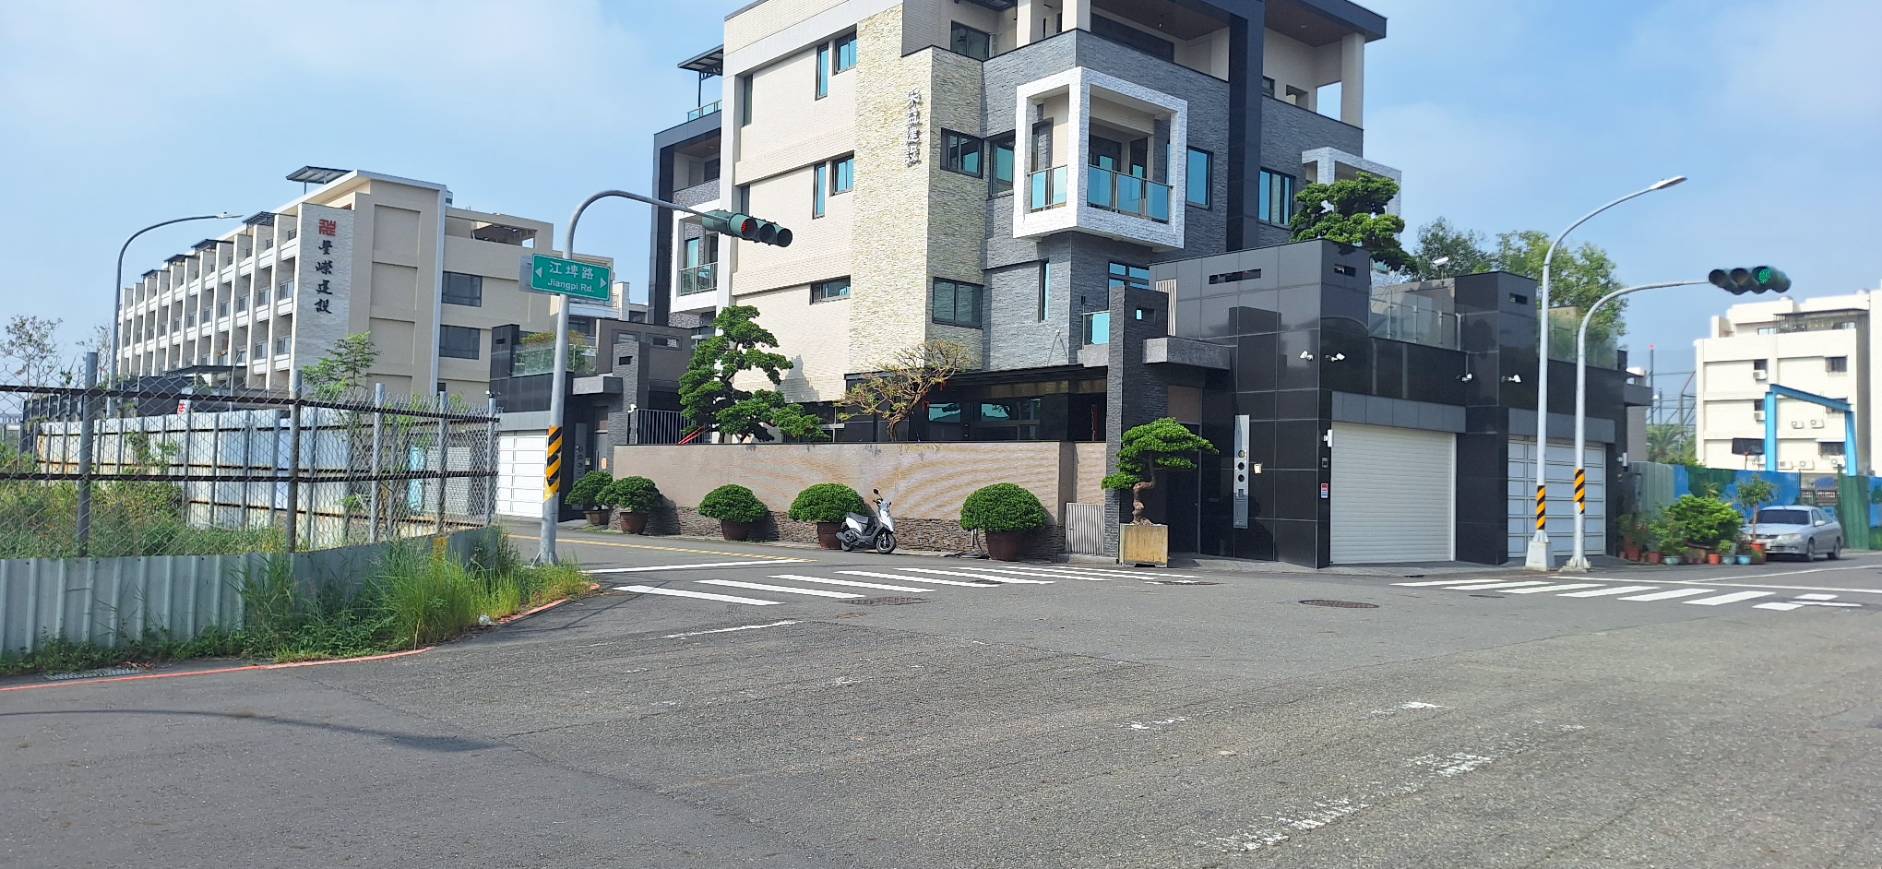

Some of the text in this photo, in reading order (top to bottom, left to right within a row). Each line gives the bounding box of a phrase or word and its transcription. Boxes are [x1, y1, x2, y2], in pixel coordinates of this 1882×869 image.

[549, 261, 594, 280] 江埤路
[547, 279, 578, 292] Jiangpi
